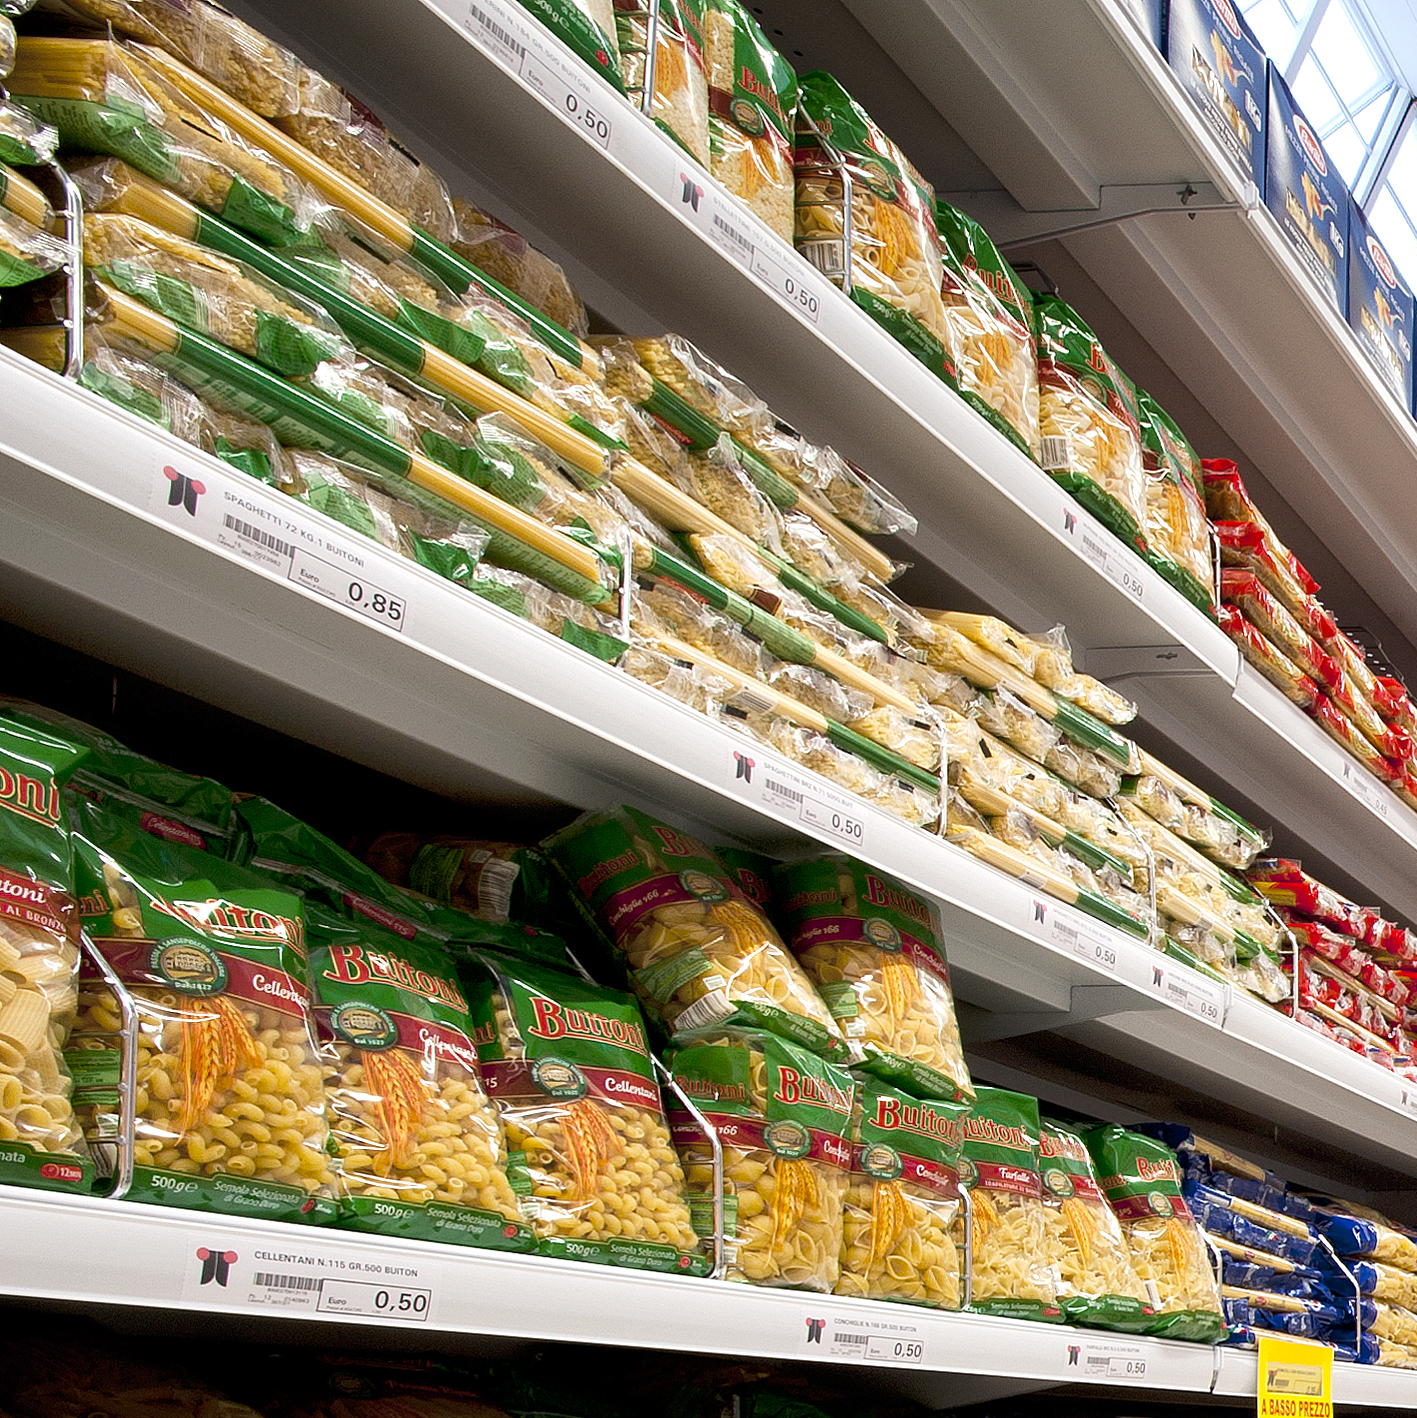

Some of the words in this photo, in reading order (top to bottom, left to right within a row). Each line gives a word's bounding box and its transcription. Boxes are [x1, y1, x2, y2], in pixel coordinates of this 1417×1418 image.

[785, 278, 818, 313] 0,50
[224, 491, 282, 526] SPAGHETTI
[284, 520, 298, 534] 72
[300, 528, 323, 547] KG.1
[326, 542, 364, 568] BUITONI
[1123, 573, 1144, 598] 0,50
[349, 582, 402, 621] 0,85
[831, 813, 862, 839] 0,50
[1095, 945, 1116, 965] 0,50
[529, 996, 646, 1056] Buitoni
[254, 1250, 315, 1266] CELLENTANI
[317, 1258, 346, 1269] N.115
[349, 1262, 382, 1273] GR.500
[385, 1266, 418, 1277] BUITON
[375, 1290, 427, 1313] 0,50
[894, 1342, 922, 1358] 0,50
[1261, 1398, 1268, 1414] A
[1269, 1398, 1296, 1417] BASSO
[1298, 1400, 1331, 1418] PREZZO
